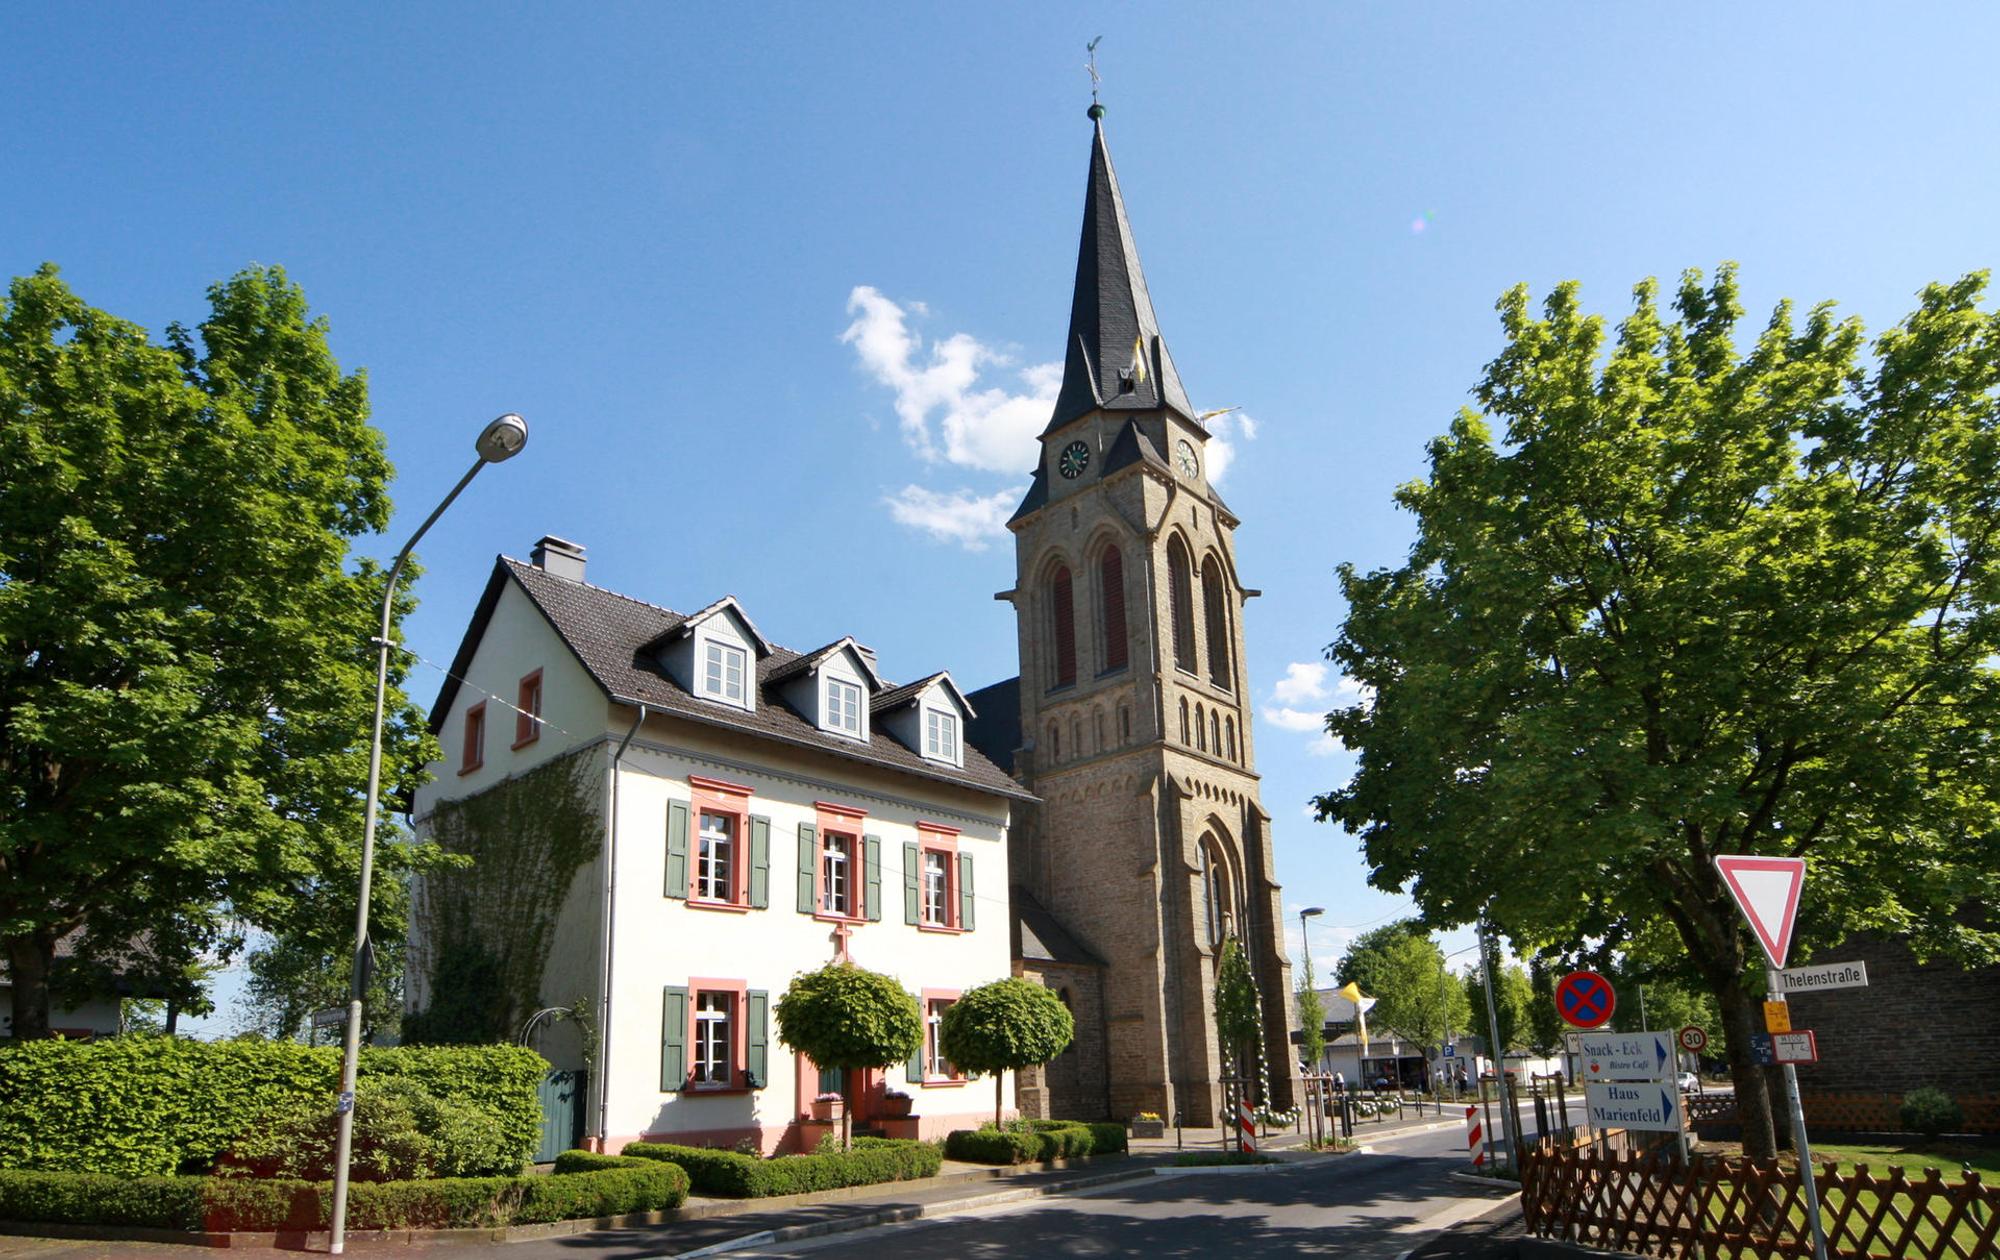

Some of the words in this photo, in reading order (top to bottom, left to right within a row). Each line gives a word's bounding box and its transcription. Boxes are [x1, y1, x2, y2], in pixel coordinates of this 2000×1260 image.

[1782, 967, 1860, 988] Thelenstraße
[1685, 1033, 1701, 1045] 30
[1584, 1043, 1613, 1057] Snack
[1622, 1041, 1642, 1056] Eck
[1609, 1061, 1631, 1070] Bistro
[1632, 1060, 1649, 1070] Café
[1608, 1087, 1640, 1100] Haus
[1593, 1107, 1661, 1122] Marienfeld
